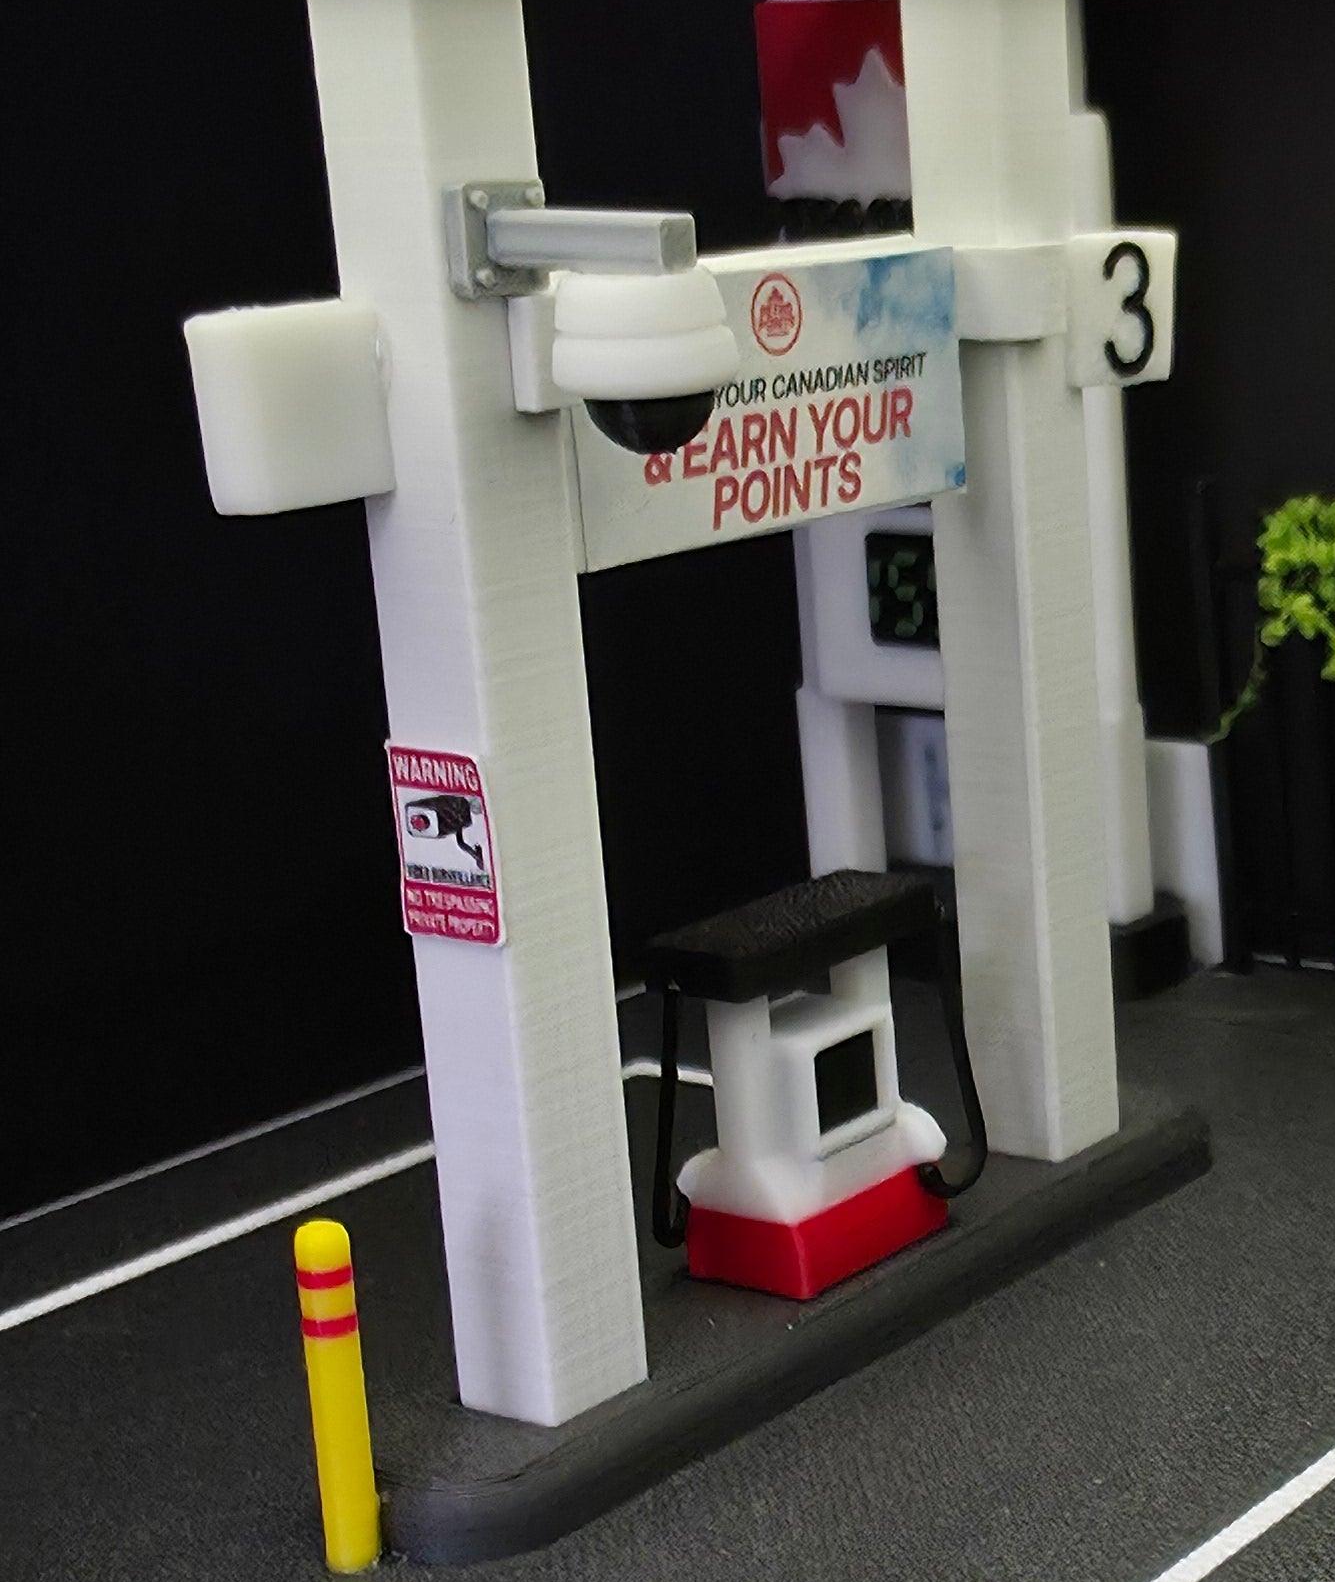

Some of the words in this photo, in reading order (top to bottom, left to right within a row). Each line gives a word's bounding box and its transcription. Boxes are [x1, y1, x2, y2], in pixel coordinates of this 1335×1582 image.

[1101, 241, 1154, 377] 3
[713, 379, 767, 409] YOUR
[772, 360, 869, 400] CANADIAN
[873, 352, 927, 383] SPIRIT
[682, 406, 798, 479] EARN
[808, 384, 914, 455] YOUR
[713, 451, 862, 531] POINTS
[393, 754, 479, 791] WARNING
